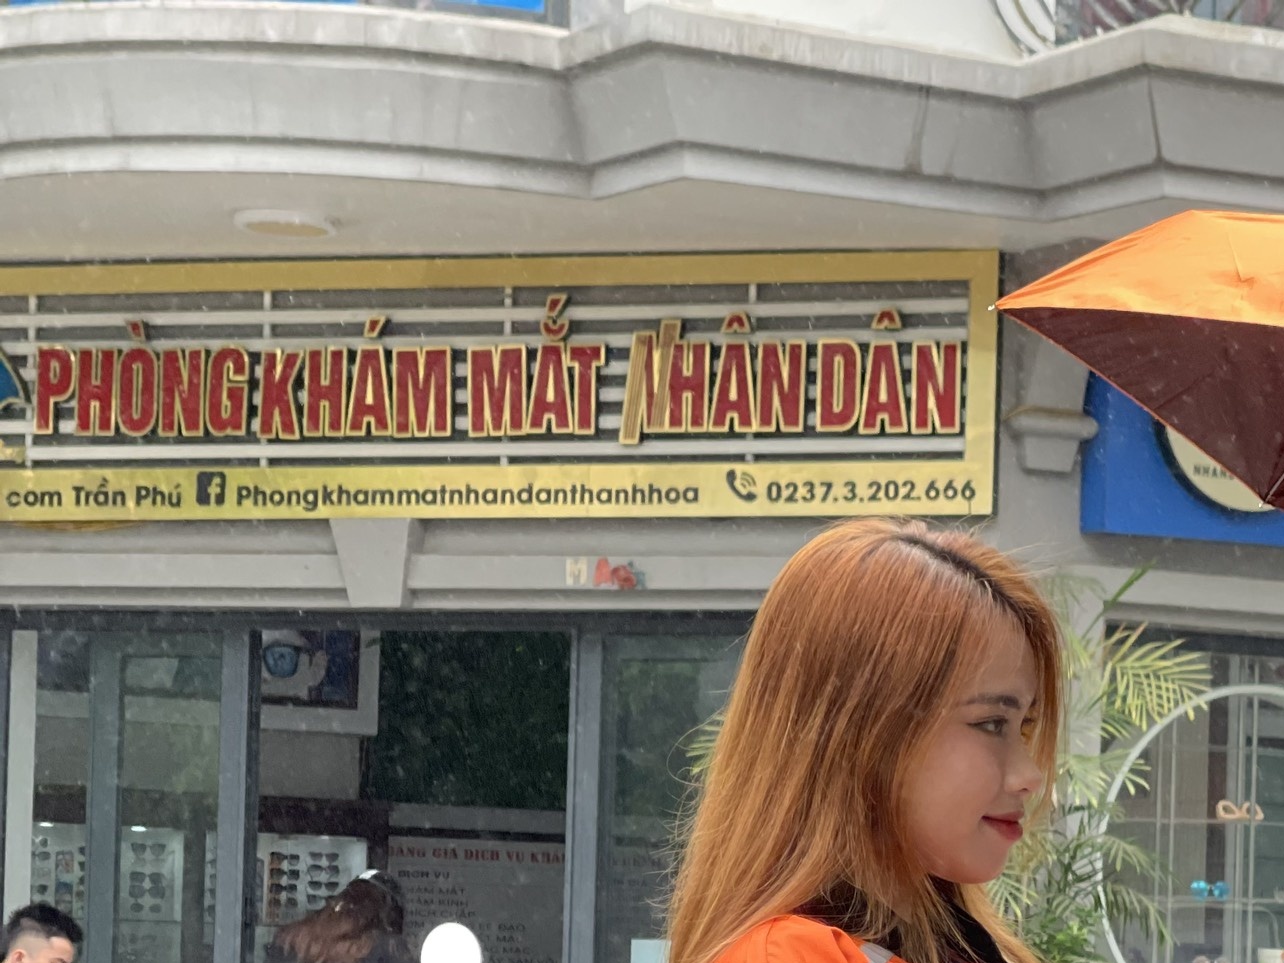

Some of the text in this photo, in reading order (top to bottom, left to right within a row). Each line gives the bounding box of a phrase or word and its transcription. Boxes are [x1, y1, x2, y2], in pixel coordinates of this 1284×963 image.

[33, 293, 961, 445] PHÒNG KHÁM MẮT NHÂN DÂN
[6, 475, 976, 512] com Trần Phú Phongkhammatnhandanthanhhoa 0237.3.202.666
